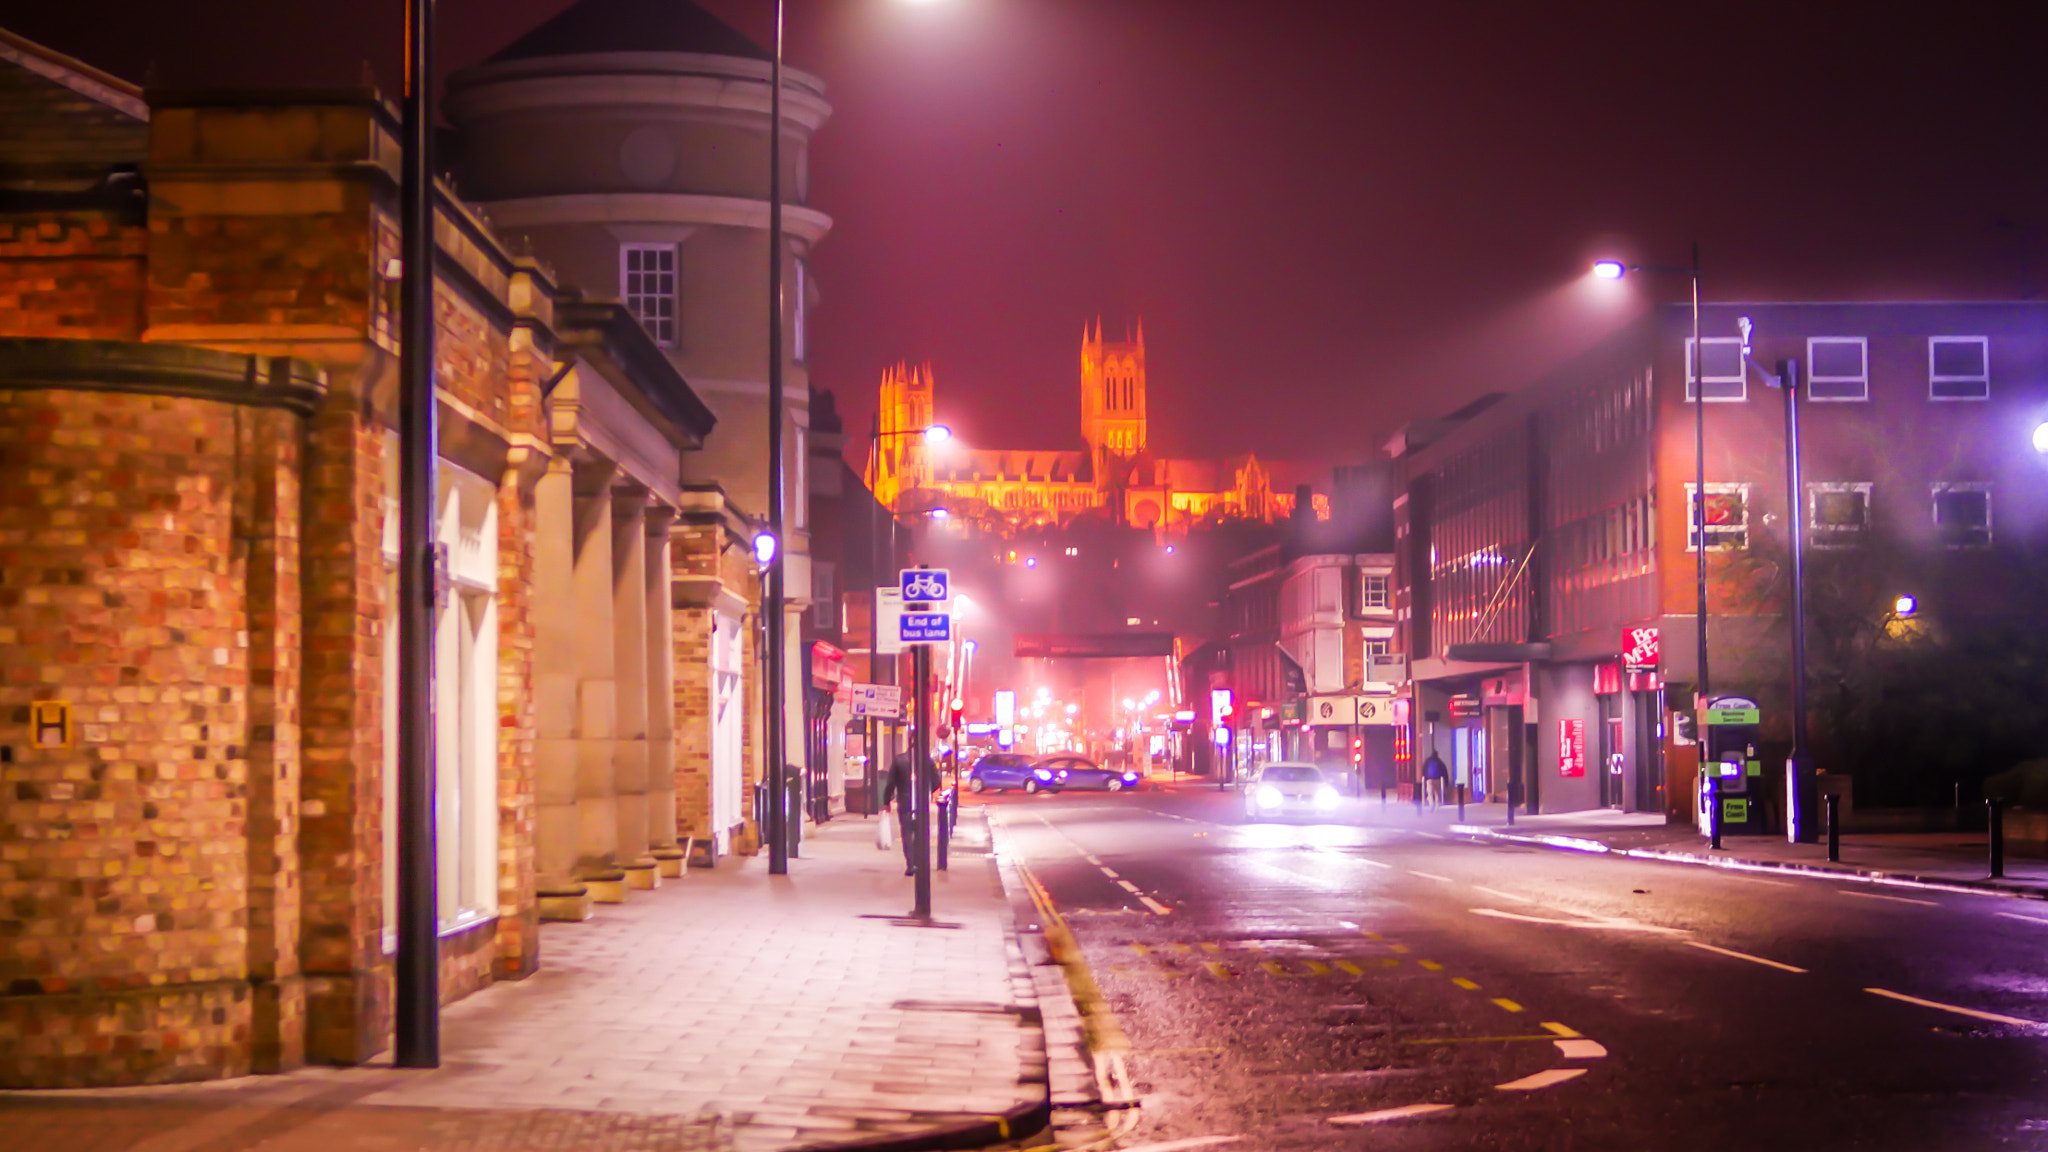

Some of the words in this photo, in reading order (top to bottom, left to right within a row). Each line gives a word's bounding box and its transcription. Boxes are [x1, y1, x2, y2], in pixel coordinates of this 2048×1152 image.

[908, 616, 928, 627] End
[931, 617, 943, 626] of
[903, 628, 922, 638] bus
[925, 628, 947, 637] lane
[37, 706, 66, 743] H
[1726, 802, 1744, 810] Free
